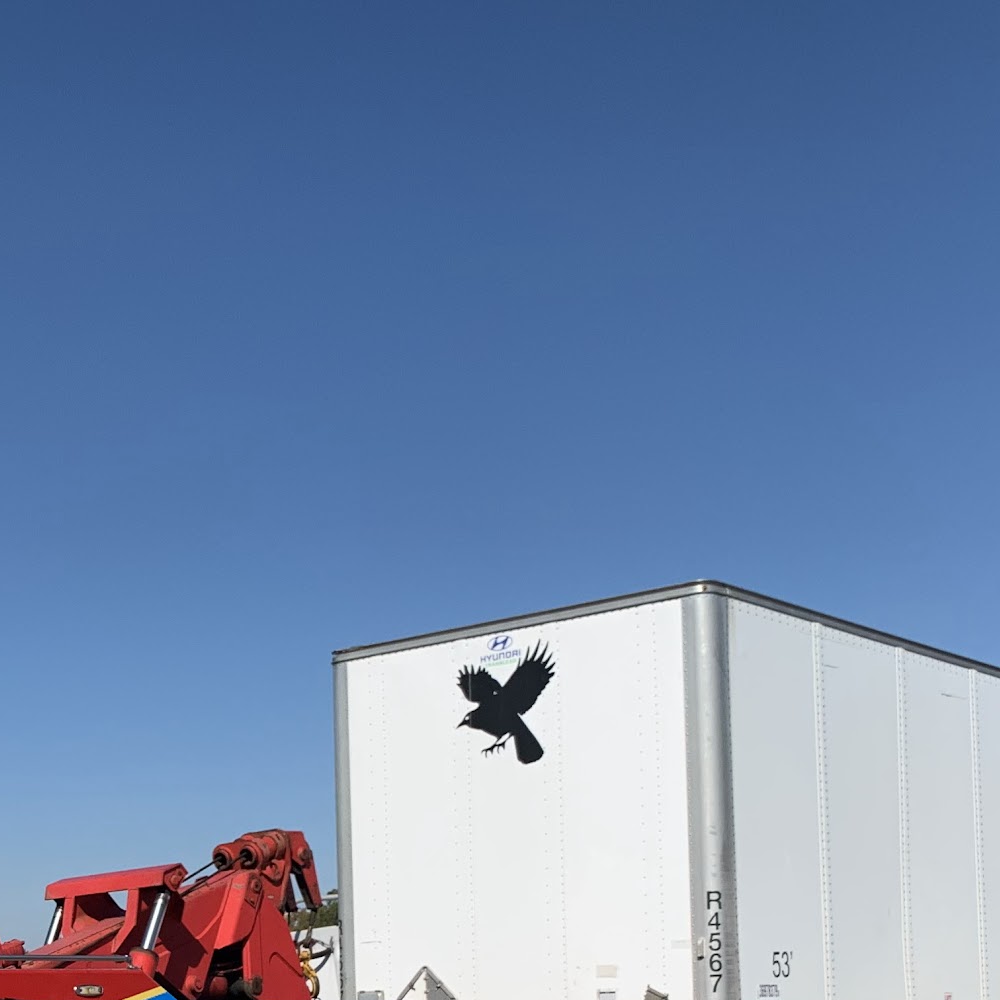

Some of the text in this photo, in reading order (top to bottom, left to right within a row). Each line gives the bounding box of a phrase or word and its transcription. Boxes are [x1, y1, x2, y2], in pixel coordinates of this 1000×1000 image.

[480, 650, 521, 663] HYUNDAI
[706, 890, 722, 993] R4567
[772, 951, 793, 978] 53'
